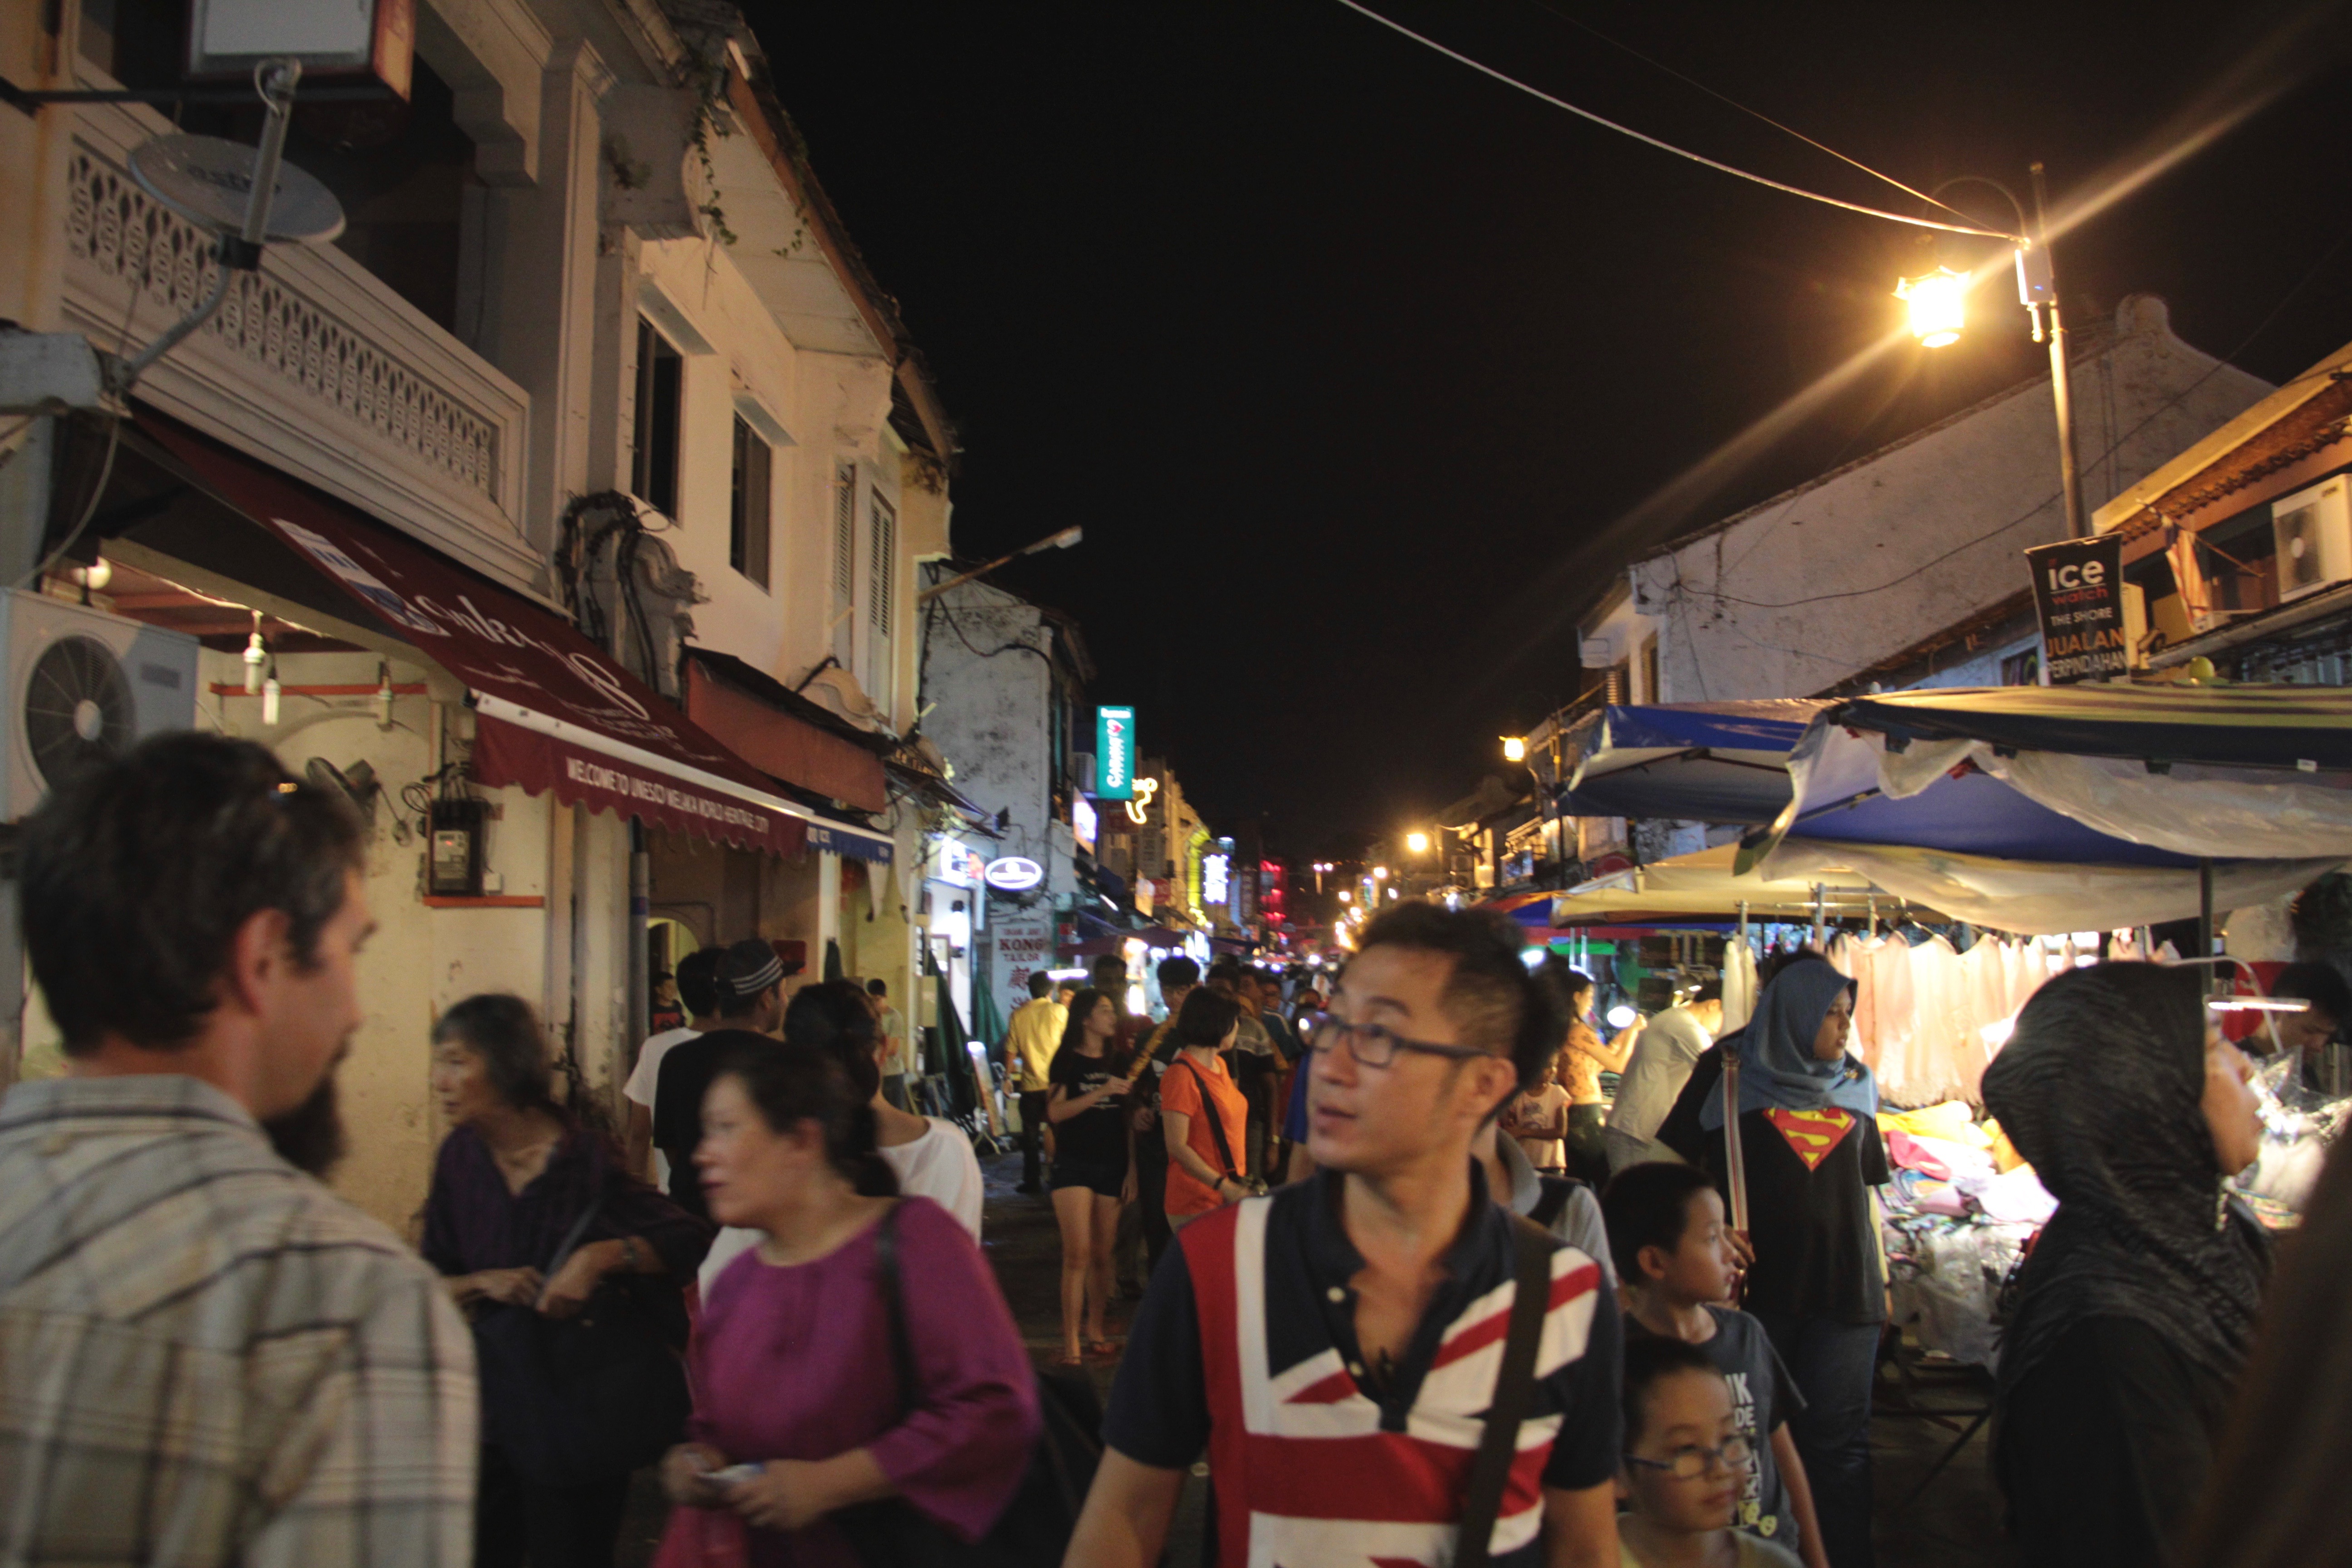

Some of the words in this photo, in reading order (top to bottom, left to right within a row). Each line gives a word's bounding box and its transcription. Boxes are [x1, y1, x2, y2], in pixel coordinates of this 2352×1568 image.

[2048, 559, 2106, 591] ice
[2052, 587, 2109, 605] watch
[2050, 613, 2072, 627] THE
[2046, 627, 2125, 658] JUALAN
[999, 938, 1044, 951] KONG
[1003, 953, 1041, 962] TAILOR
